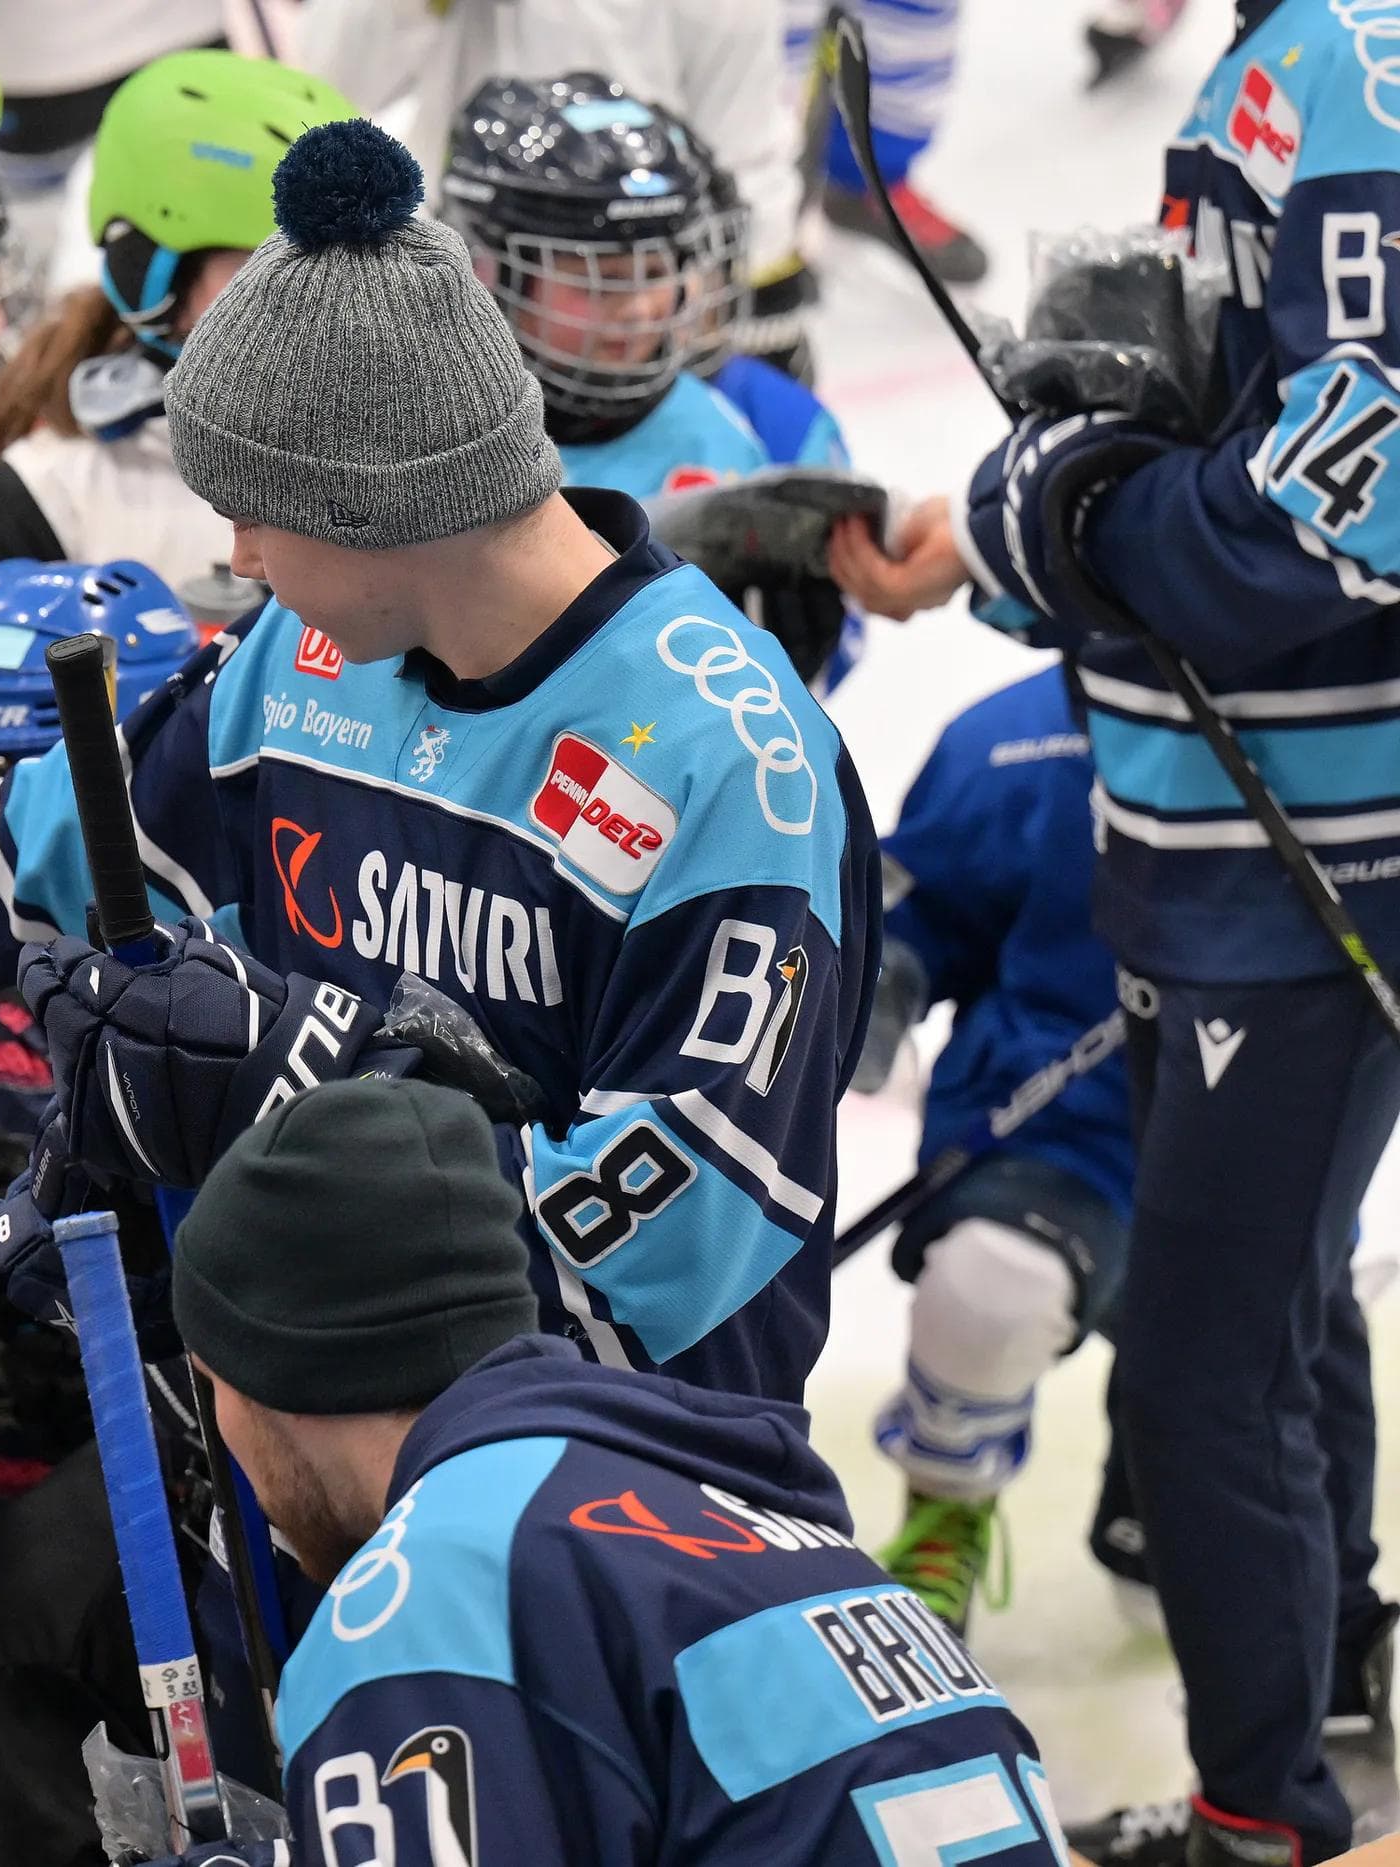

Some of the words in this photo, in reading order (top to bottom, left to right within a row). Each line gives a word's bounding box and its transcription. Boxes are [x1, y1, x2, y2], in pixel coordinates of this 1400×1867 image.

[1265, 360, 1400, 540] 14
[263, 692, 297, 735] gio
[302, 698, 372, 749] Bayern
[581, 797, 650, 861] DEL
[122, 1071, 141, 1122] VAPOR
[535, 1119, 698, 1269] 8
[803, 1590, 1001, 1723] BRU
